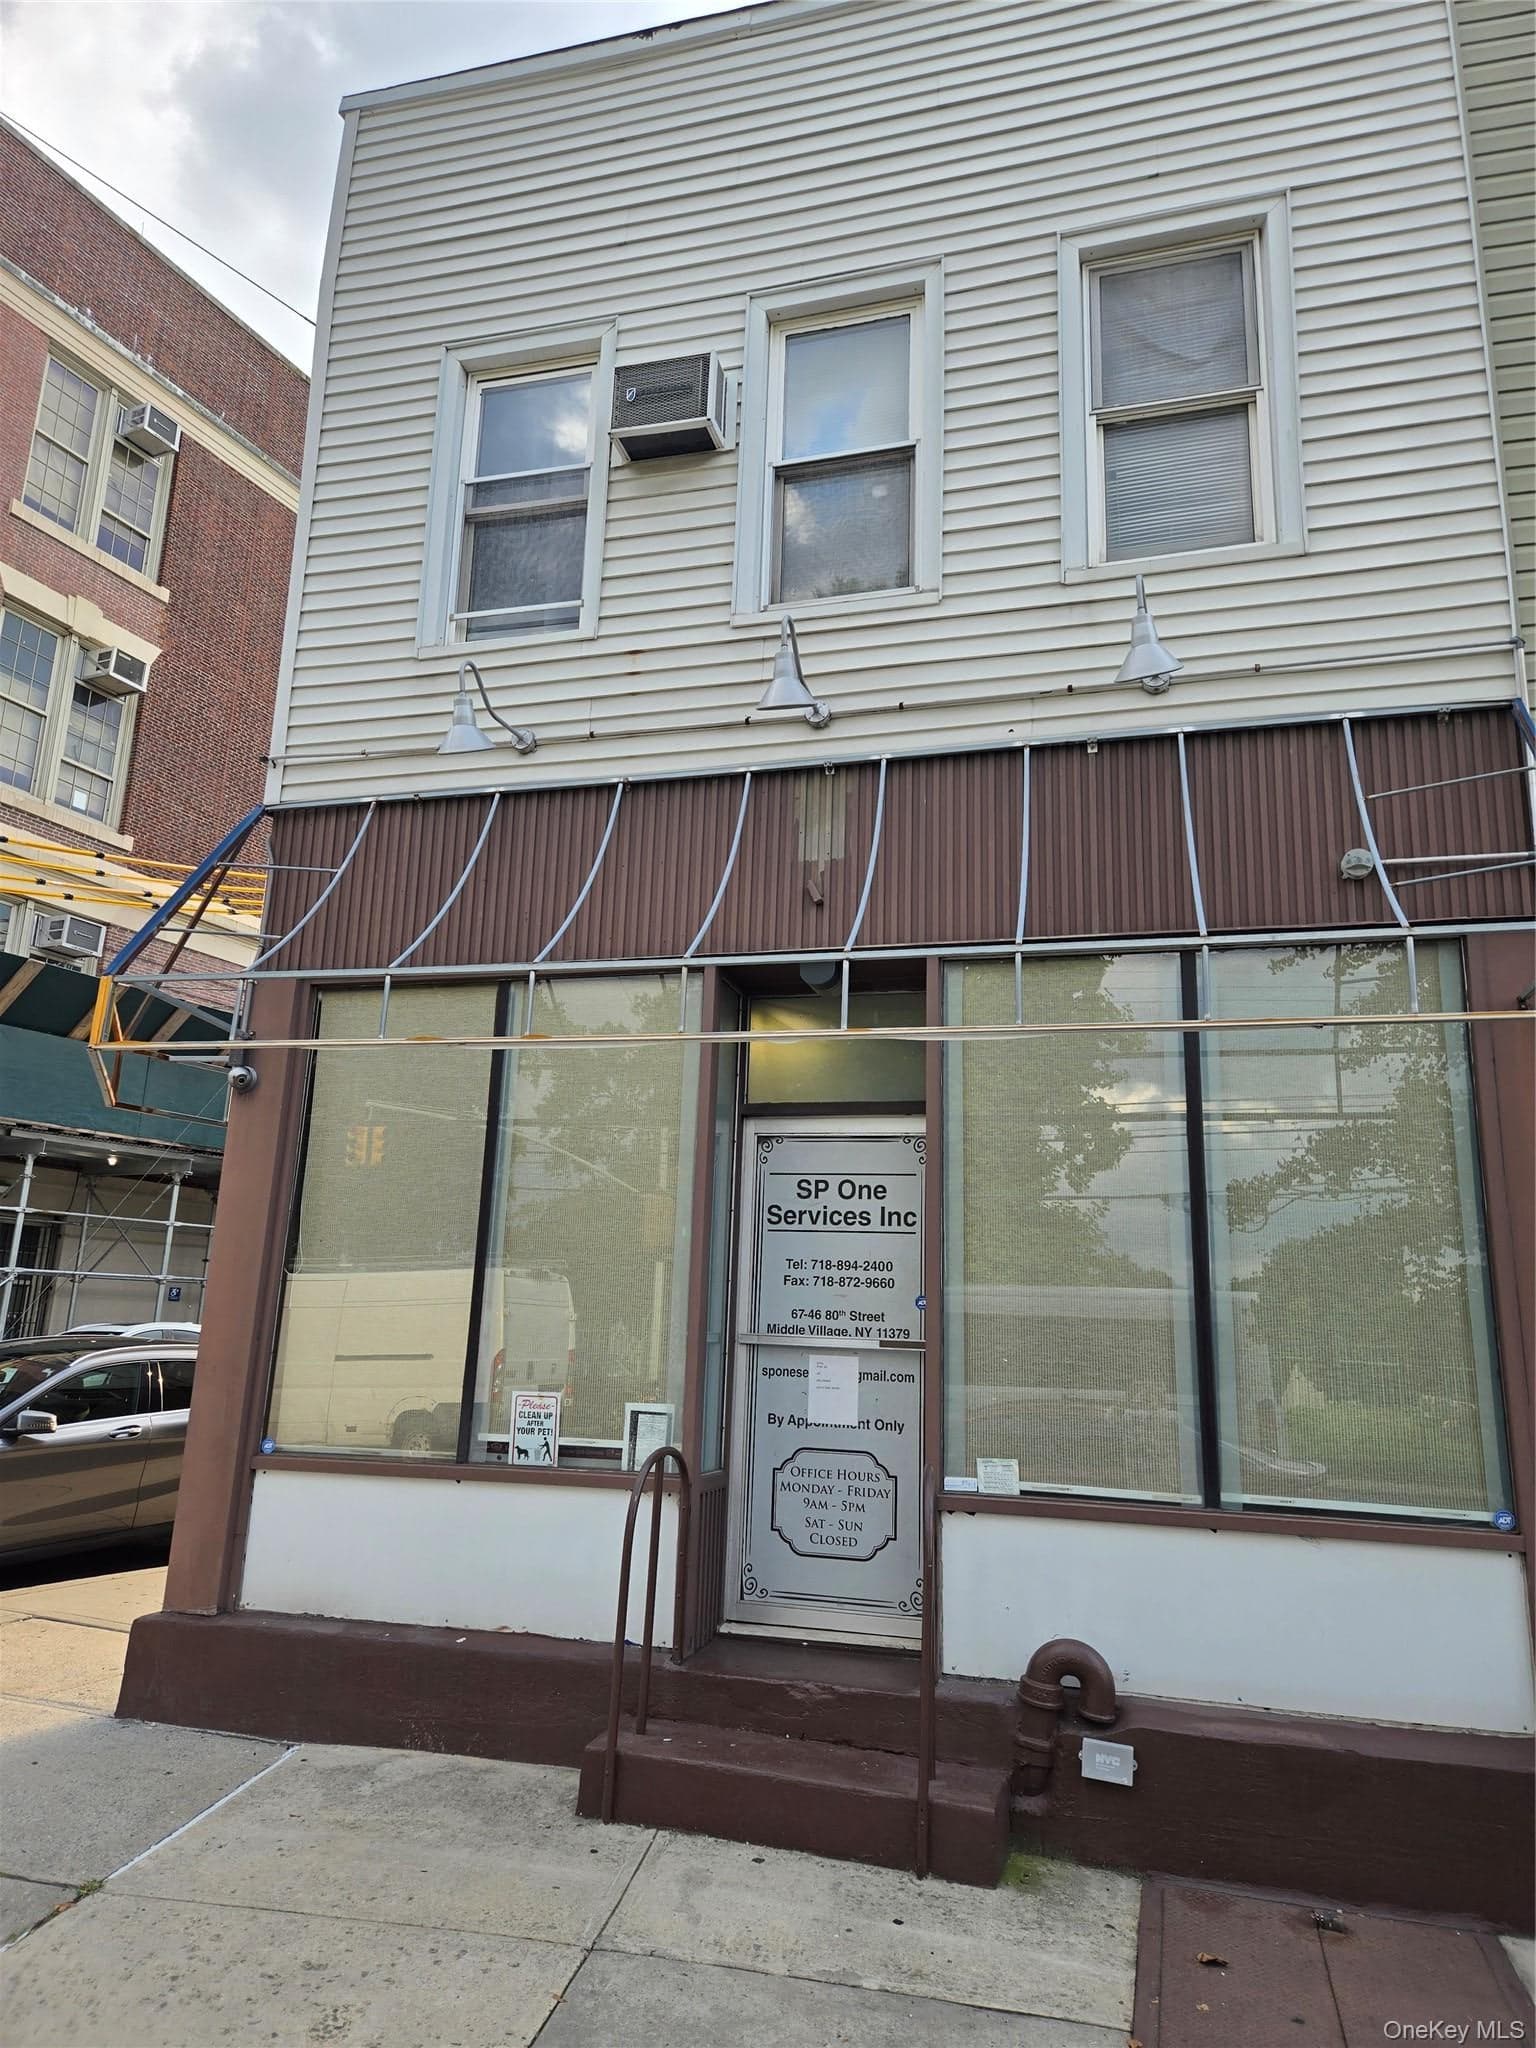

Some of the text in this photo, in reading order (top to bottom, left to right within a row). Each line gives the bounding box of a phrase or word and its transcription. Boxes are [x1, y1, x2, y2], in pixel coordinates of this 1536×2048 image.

[796, 1179, 887, 1200] SP One
[767, 1204, 917, 1227] Services Inc
[786, 1259, 893, 1272] Tel: 718-894-2400
[783, 1275, 895, 1289] Fax: 718-872-9660
[791, 1310, 822, 1321] 67-46
[849, 1311, 885, 1323] Street
[767, 1324, 805, 1336] Middle
[855, 1327, 872, 1338] NY
[876, 1328, 910, 1339] 11379
[518, 1411, 554, 1420] CLEAN UP
[767, 1413, 784, 1427] By
[874, 1418, 904, 1434] Only
[517, 1427, 553, 1436] YOUR PET!
[803, 1498, 828, 1511] 9AM
[840, 1501, 866, 1513] 5PM
[809, 1533, 858, 1547] CLOSED
